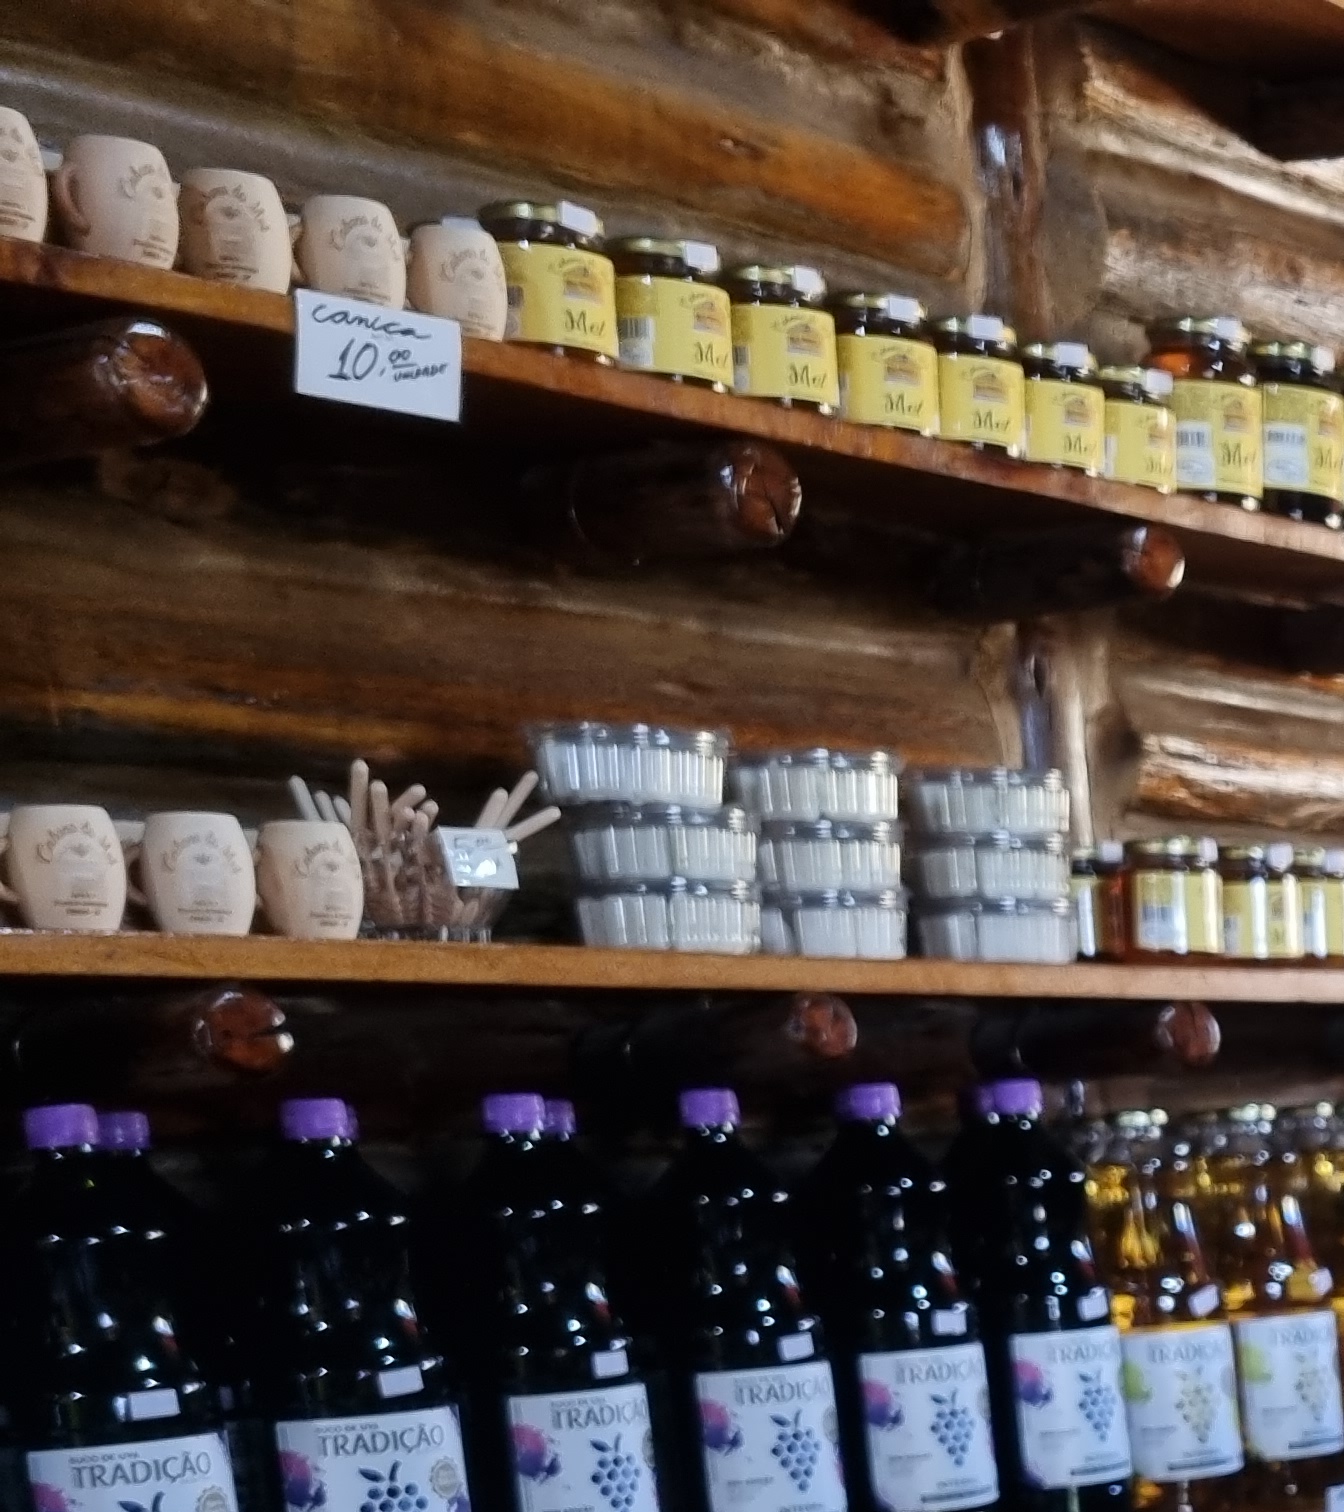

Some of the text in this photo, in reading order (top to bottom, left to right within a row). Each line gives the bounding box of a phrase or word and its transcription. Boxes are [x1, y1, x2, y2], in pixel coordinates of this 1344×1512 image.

[564, 308, 606, 339] Mel
[693, 341, 729, 368] Mel
[788, 364, 828, 390] Mel
[885, 392, 923, 417] Mel
[972, 409, 1010, 432] Mel
[1063, 432, 1097, 456] Mel
[1222, 439, 1258, 468] Mel
[318, 1423, 445, 1457] TRADIÇÃO
[72, 1451, 212, 1489] TRADIÇÃO
